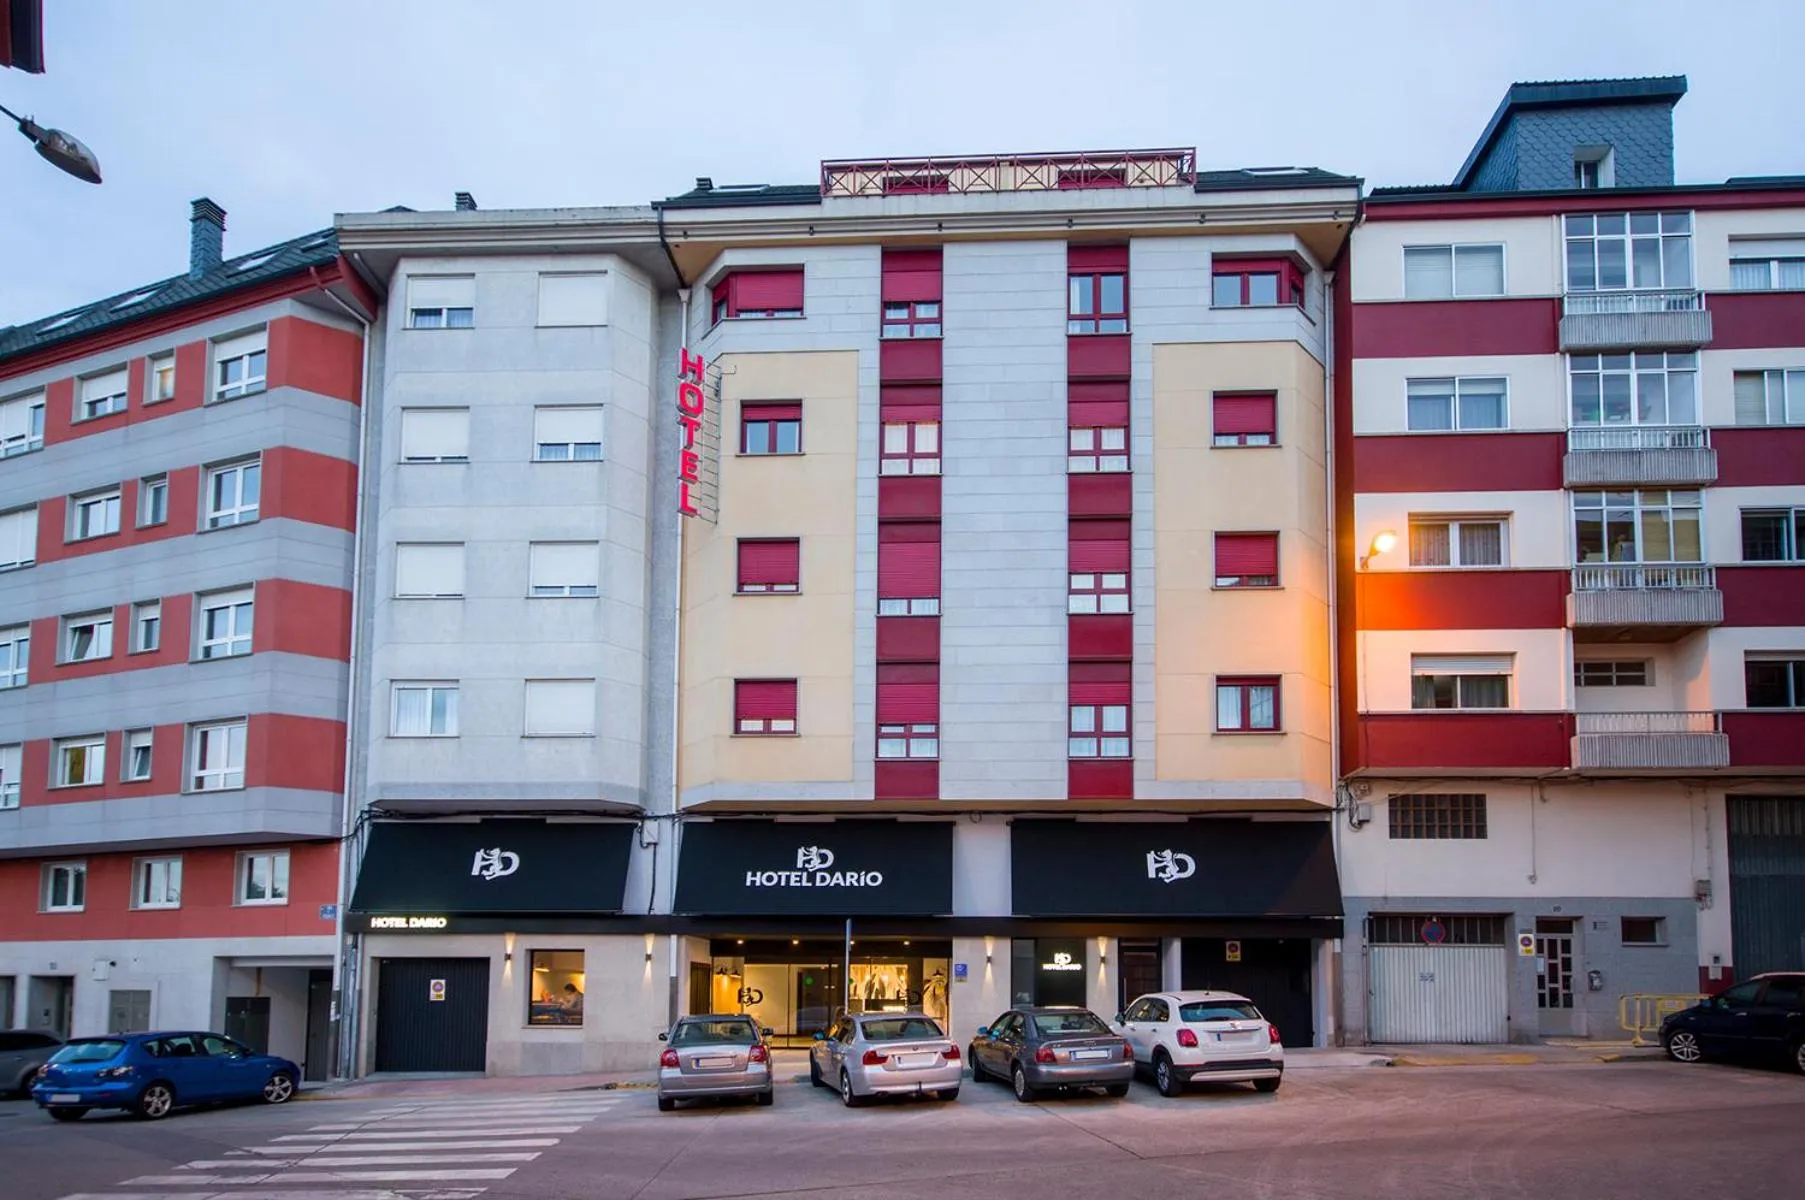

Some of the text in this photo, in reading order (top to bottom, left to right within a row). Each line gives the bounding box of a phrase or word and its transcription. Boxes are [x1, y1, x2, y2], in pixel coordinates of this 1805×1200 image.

[677, 347, 705, 518] HOTEL
[745, 871, 812, 887] HOTEL
[370, 917, 409, 929] HOTEL
